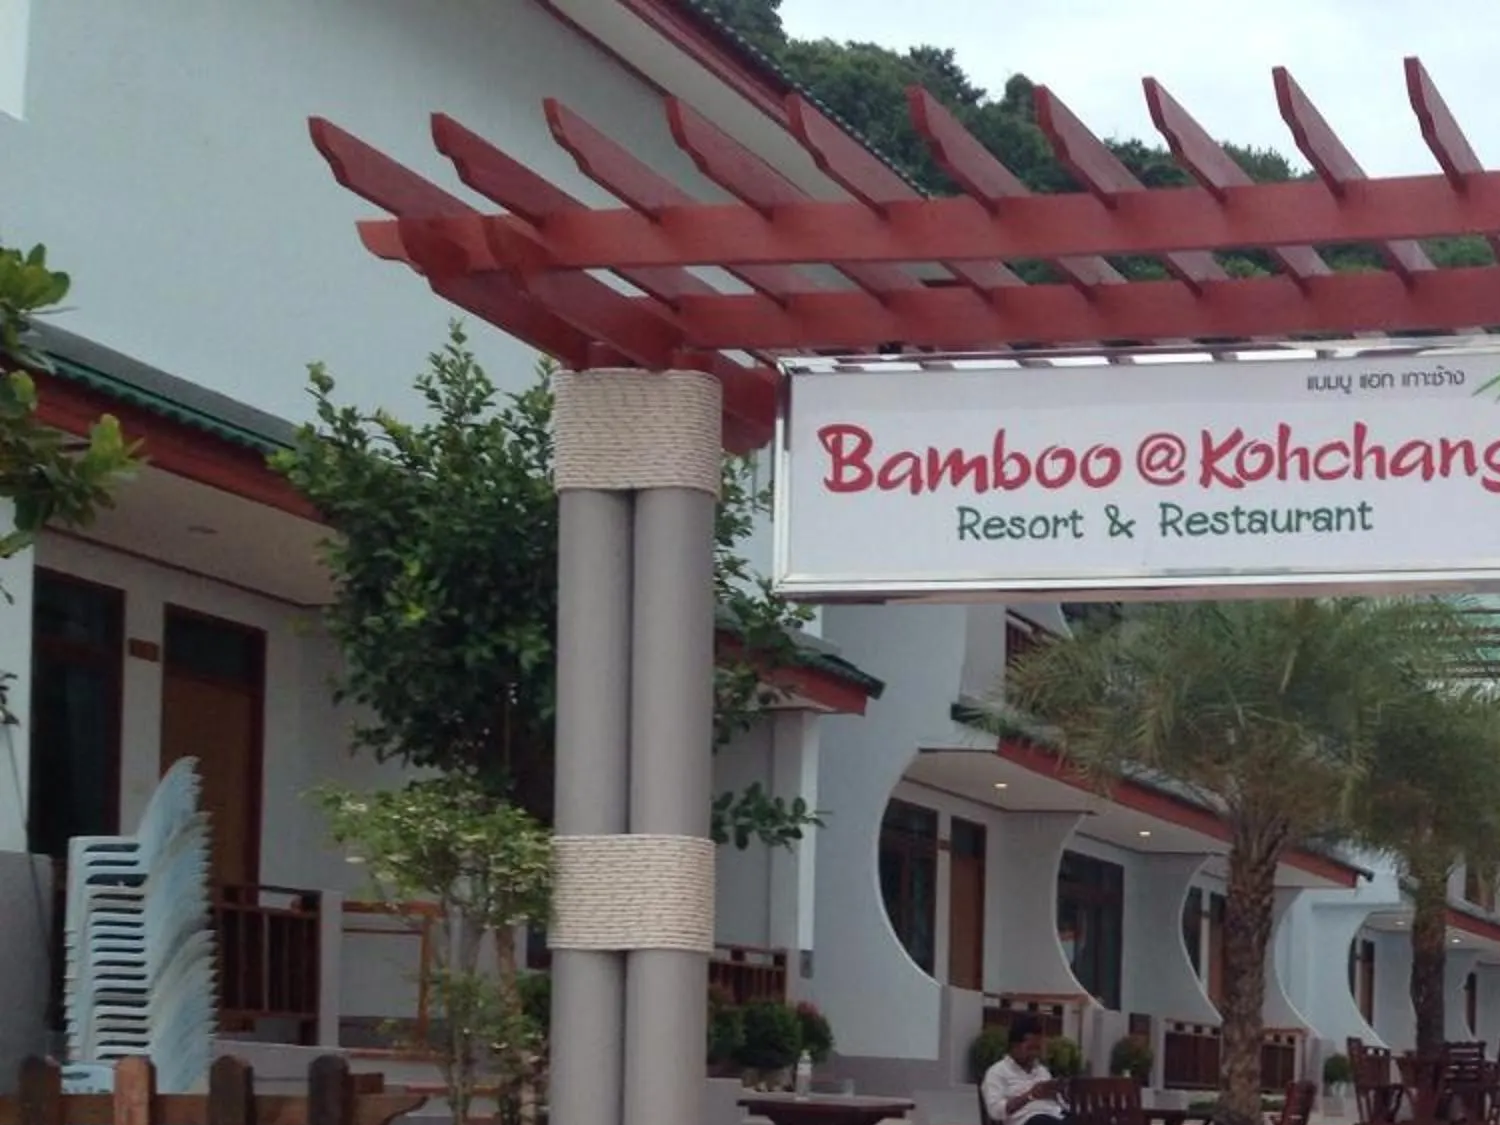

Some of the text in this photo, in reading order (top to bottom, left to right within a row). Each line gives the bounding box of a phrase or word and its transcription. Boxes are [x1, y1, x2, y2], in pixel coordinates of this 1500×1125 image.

[817, 423, 1123, 495] Bamboo
[1136, 432, 1186, 486] @
[957, 501, 1373, 541] Resort & Restaurant
